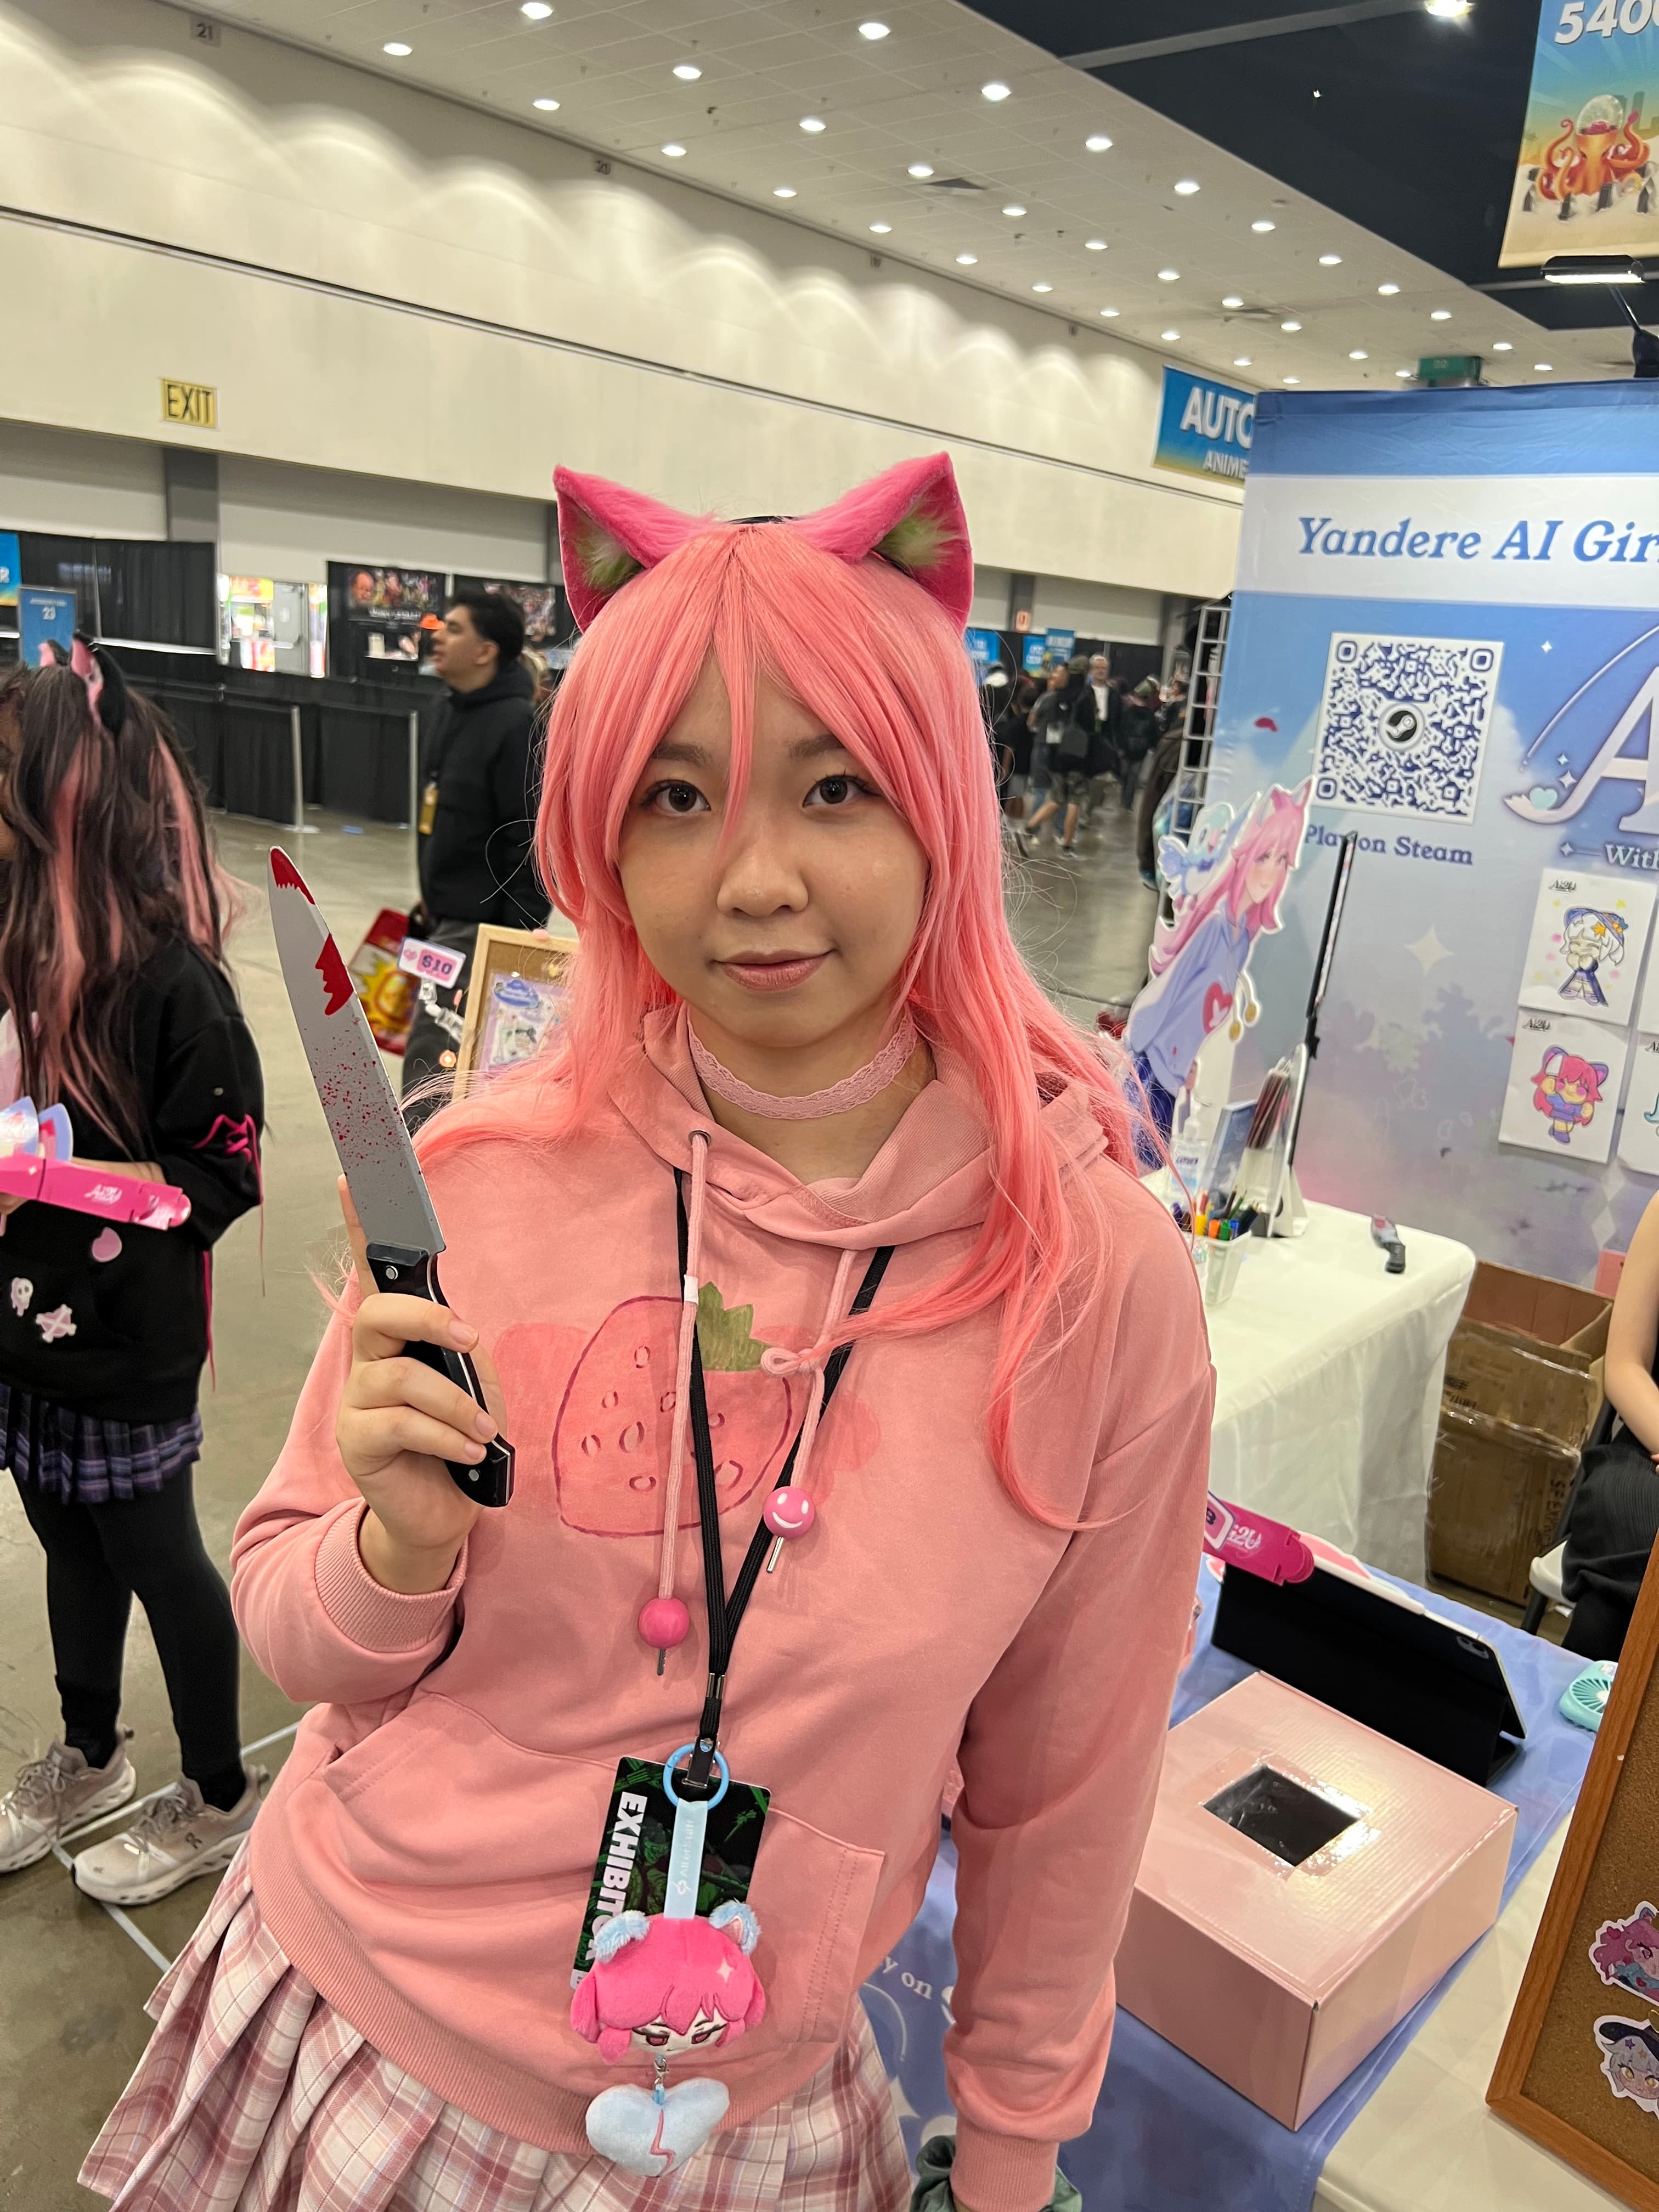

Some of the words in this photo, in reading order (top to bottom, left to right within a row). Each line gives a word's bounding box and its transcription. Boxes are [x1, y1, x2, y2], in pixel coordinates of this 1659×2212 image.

[196, 23, 212, 41] 21
[1554, 0, 1659, 44] 540
[167, 384, 211, 424] EXIT
[1203, 450, 1249, 480] ANIME
[1299, 517, 1481, 560] Yandere
[1492, 520, 1564, 561] AI
[1573, 520, 1659, 563] Gir
[1358, 837, 1386, 854] on
[1393, 836, 1474, 866] Steam
[421, 954, 453, 975] $10
[1228, 1524, 1262, 1550] i2U
[585, 1791, 647, 1961] EXHIBIT
[901, 1971, 933, 2000] on
